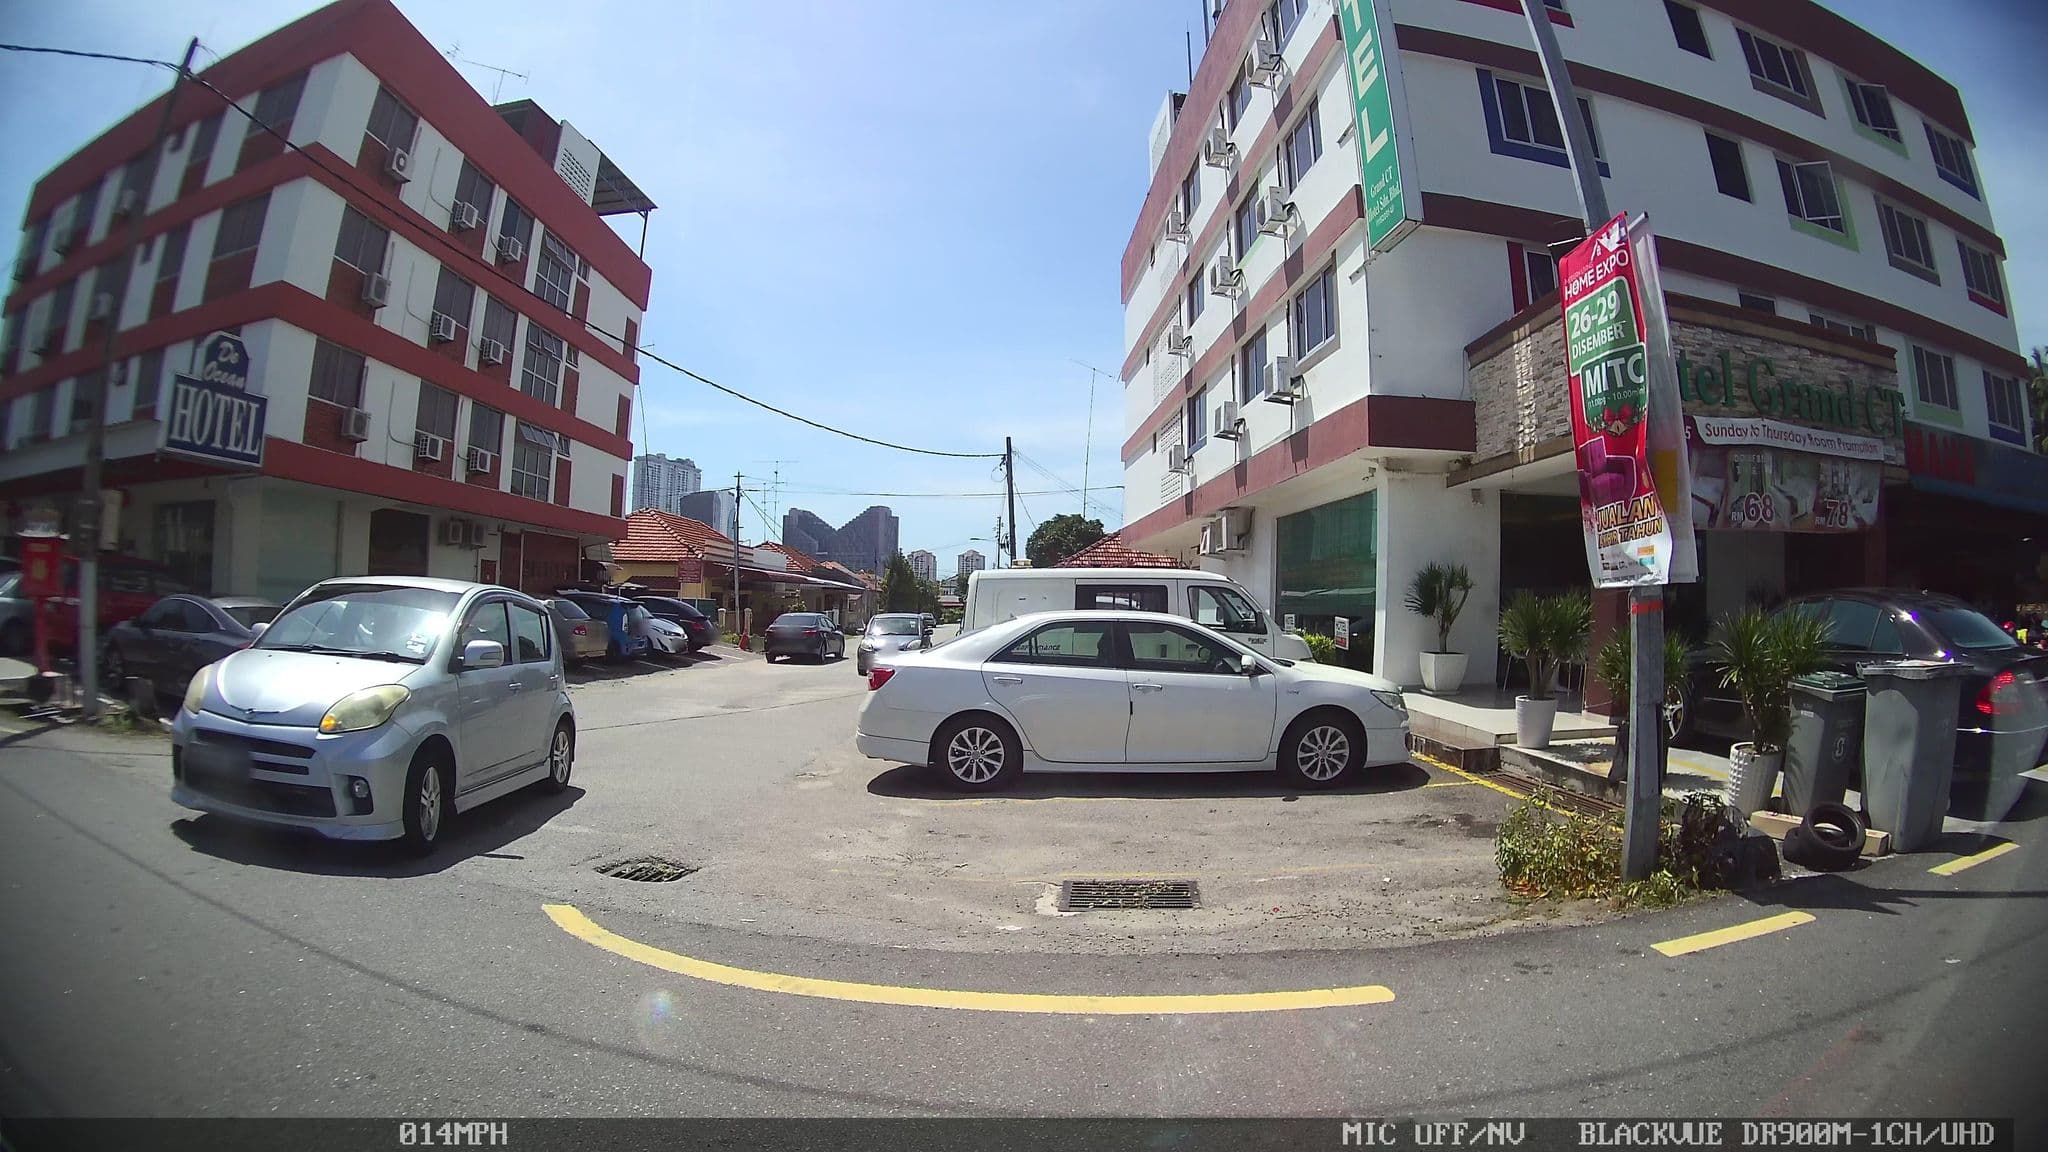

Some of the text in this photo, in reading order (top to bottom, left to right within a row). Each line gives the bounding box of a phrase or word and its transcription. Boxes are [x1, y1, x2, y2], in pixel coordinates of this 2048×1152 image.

[1564, 268, 1595, 300] HOME
[1596, 249, 1629, 281] EXPO
[1571, 290, 1620, 339] 26-29
[1572, 320, 1625, 359] DISEMBER
[1585, 352, 1645, 398] MITC
[1678, 349, 1905, 438] tel Grand CT
[169, 383, 260, 456] HOTEL
[1705, 423, 1748, 438] Sunday
[1761, 424, 1807, 447] Thursday
[1807, 432, 1837, 450] Room
[1731, 492, 1774, 524] RM 68
[1825, 499, 1849, 528] 78
[1619, 517, 1664, 543] TAHUN
